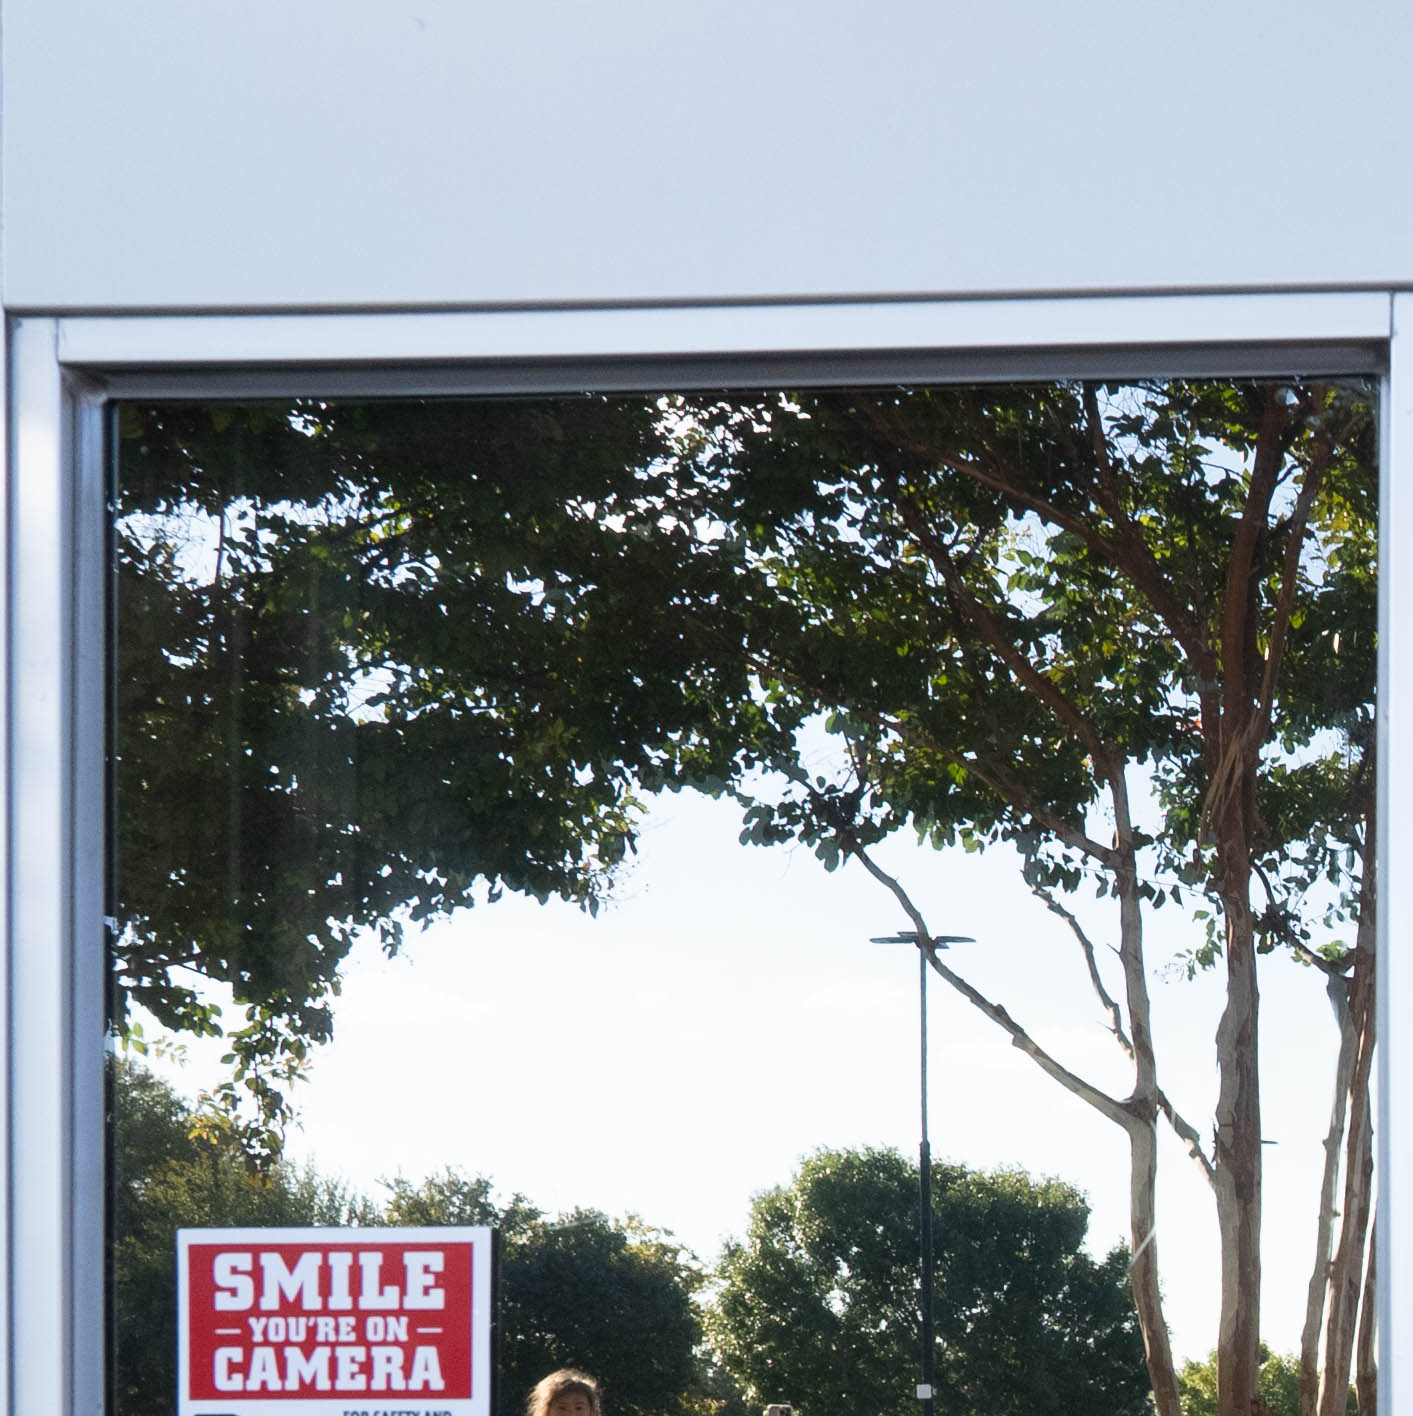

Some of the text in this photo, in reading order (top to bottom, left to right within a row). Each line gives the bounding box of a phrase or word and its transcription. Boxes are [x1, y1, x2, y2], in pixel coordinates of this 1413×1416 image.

[213, 1251, 445, 1311] SMILE
[248, 1316, 408, 1342] YOU'RE ON
[213, 1346, 445, 1391] CAMERA
